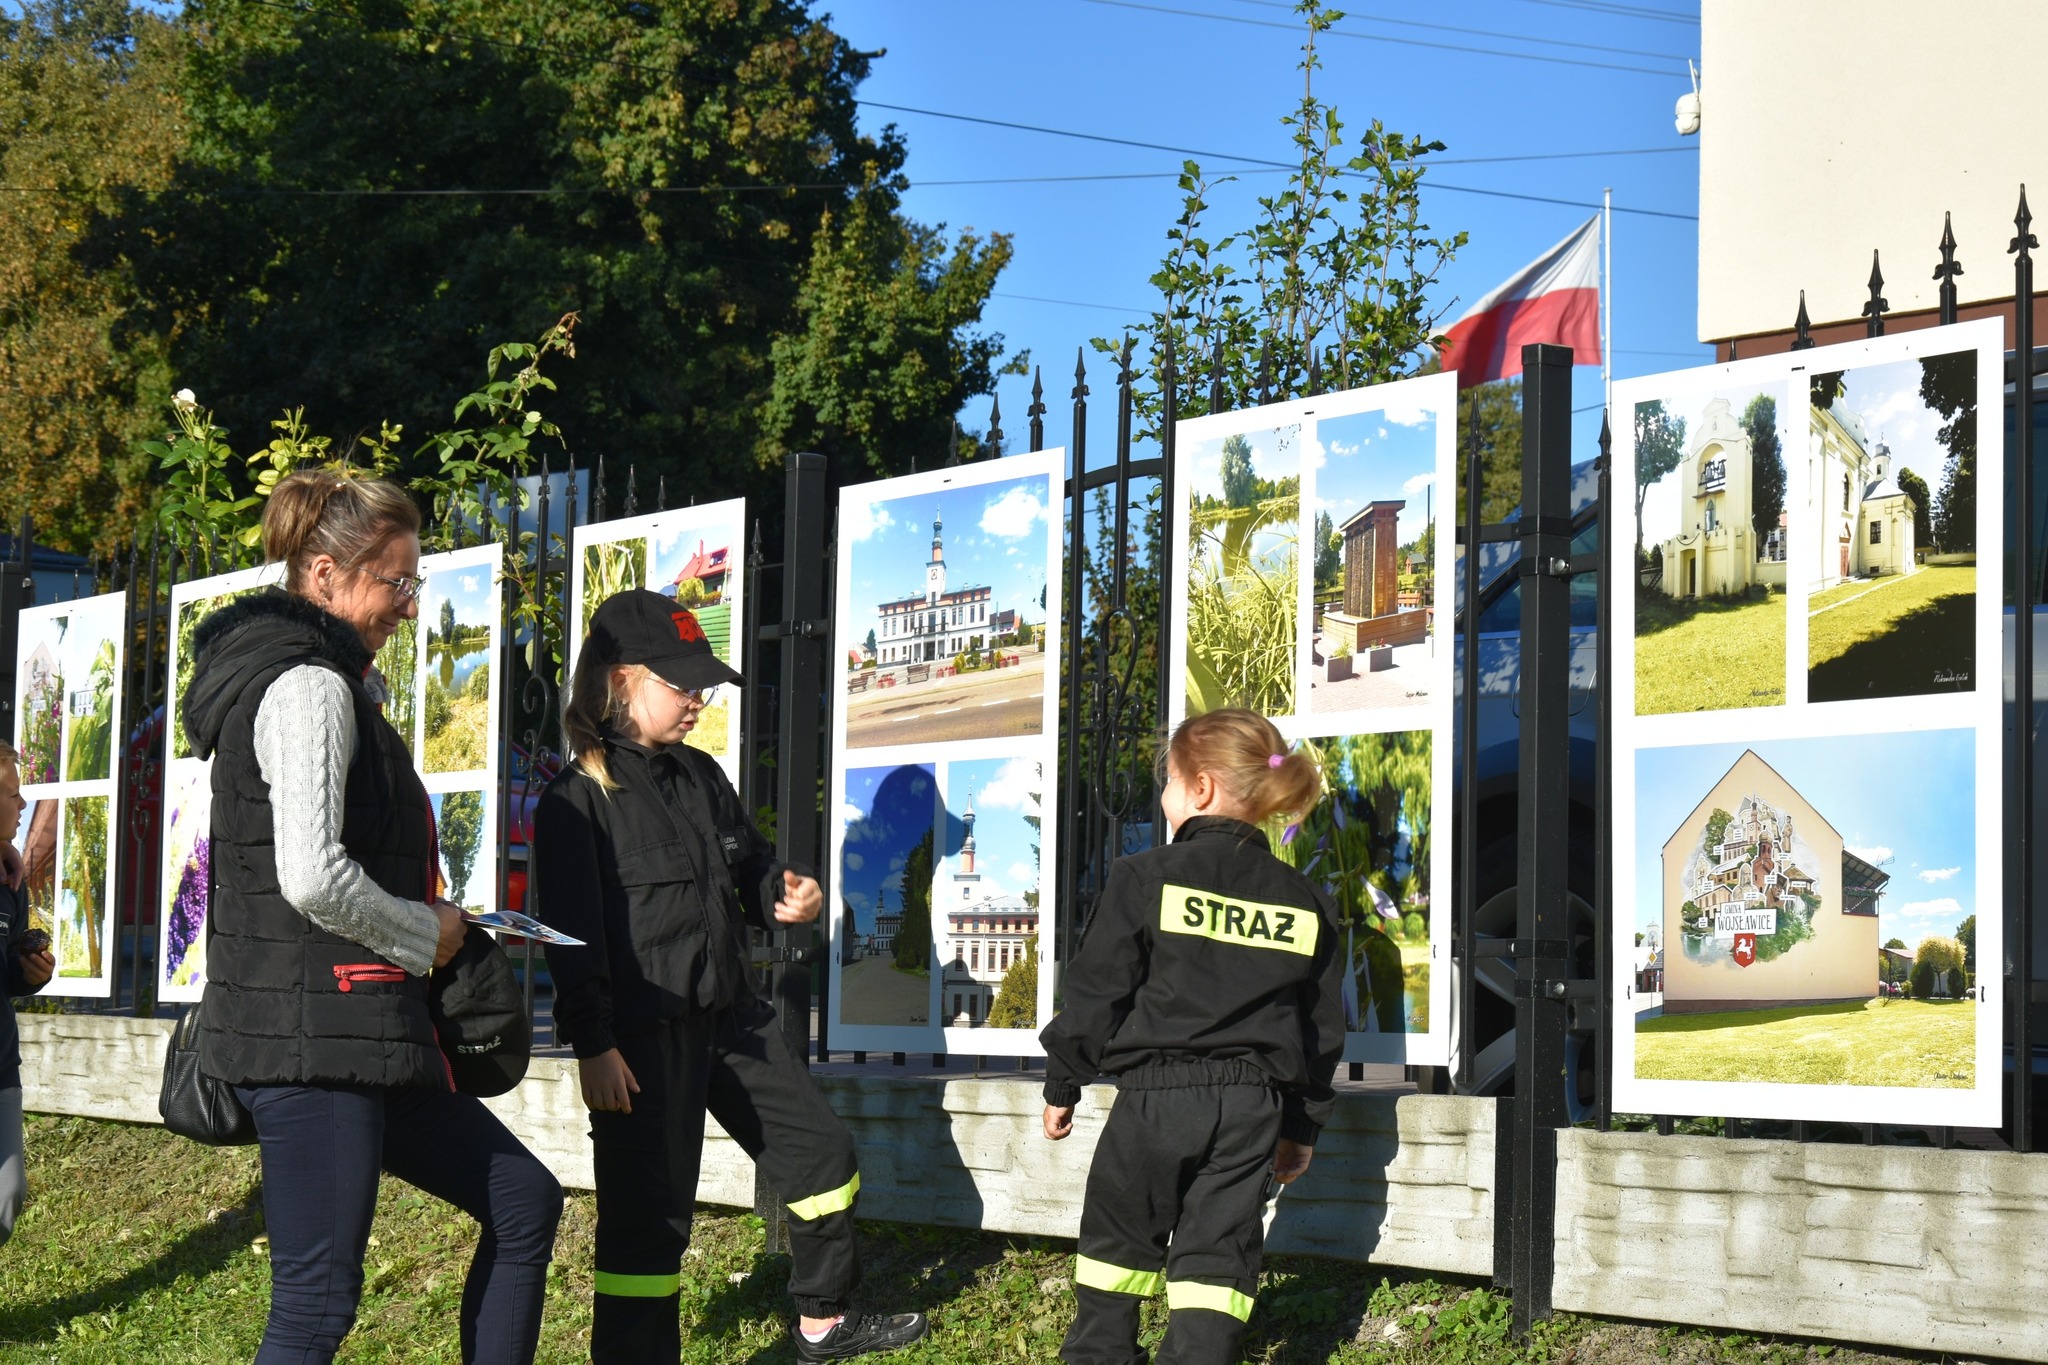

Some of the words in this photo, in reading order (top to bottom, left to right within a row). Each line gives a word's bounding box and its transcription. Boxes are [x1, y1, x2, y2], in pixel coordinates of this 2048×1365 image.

[1724, 904, 1742, 914] GMINA
[1717, 914, 1772, 931] WOJSŁAWICE
[457, 1035, 501, 1054] STRAŻ
